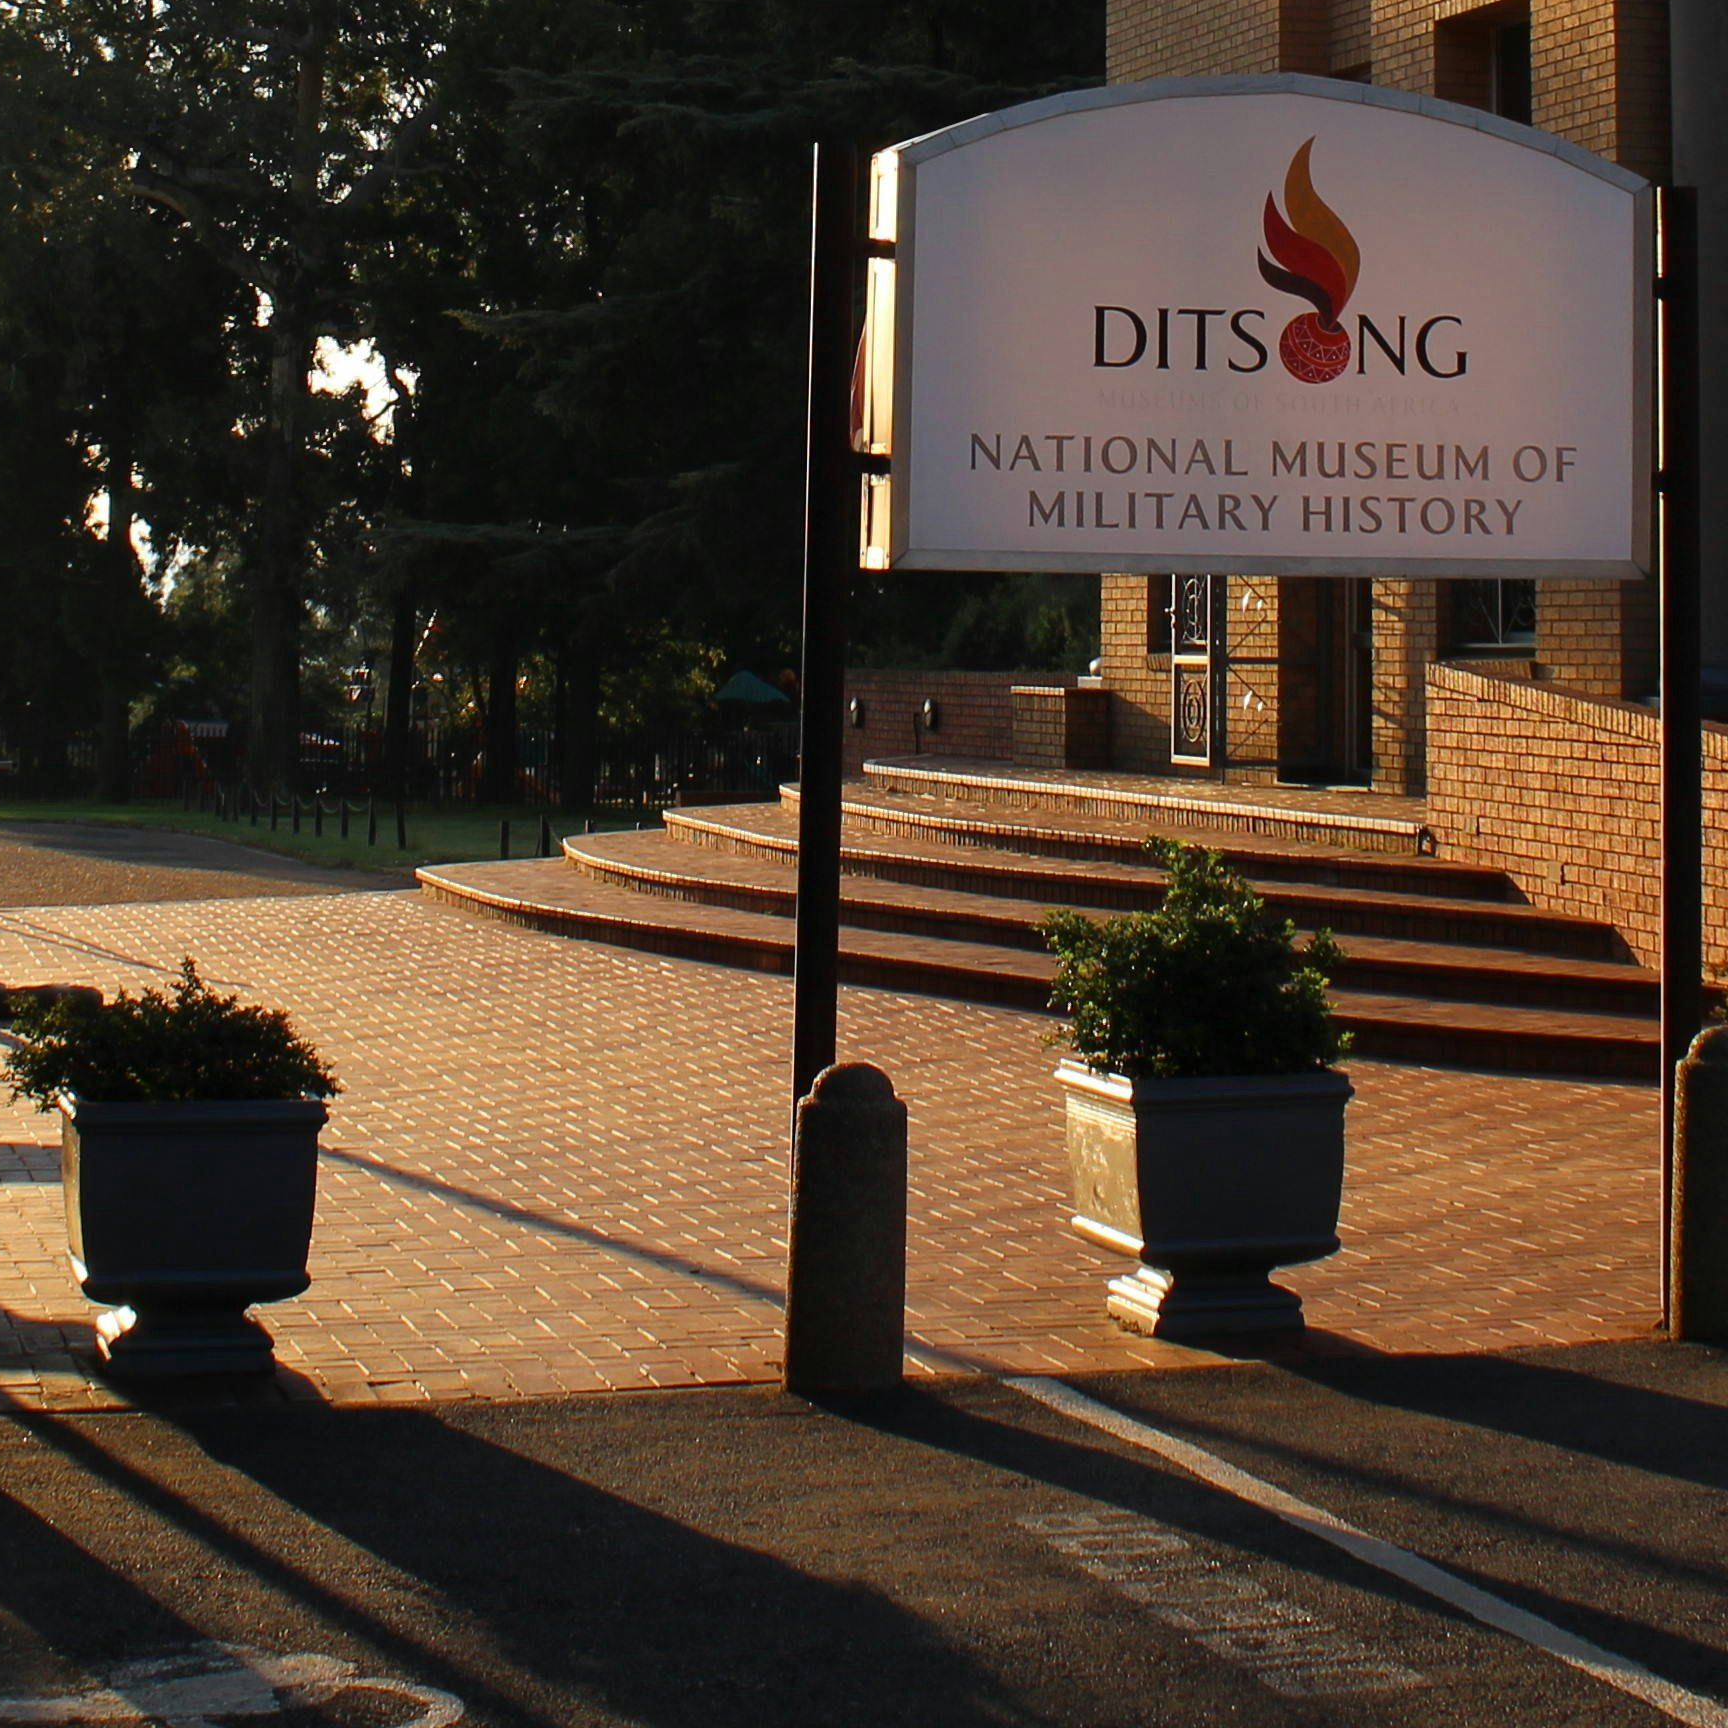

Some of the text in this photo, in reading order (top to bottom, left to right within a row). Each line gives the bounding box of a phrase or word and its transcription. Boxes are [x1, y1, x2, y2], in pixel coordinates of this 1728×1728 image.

[969, 431, 1578, 483] NATIONAL MUSEUM OF
[1027, 489, 1524, 536] MILITARY HISTORY
